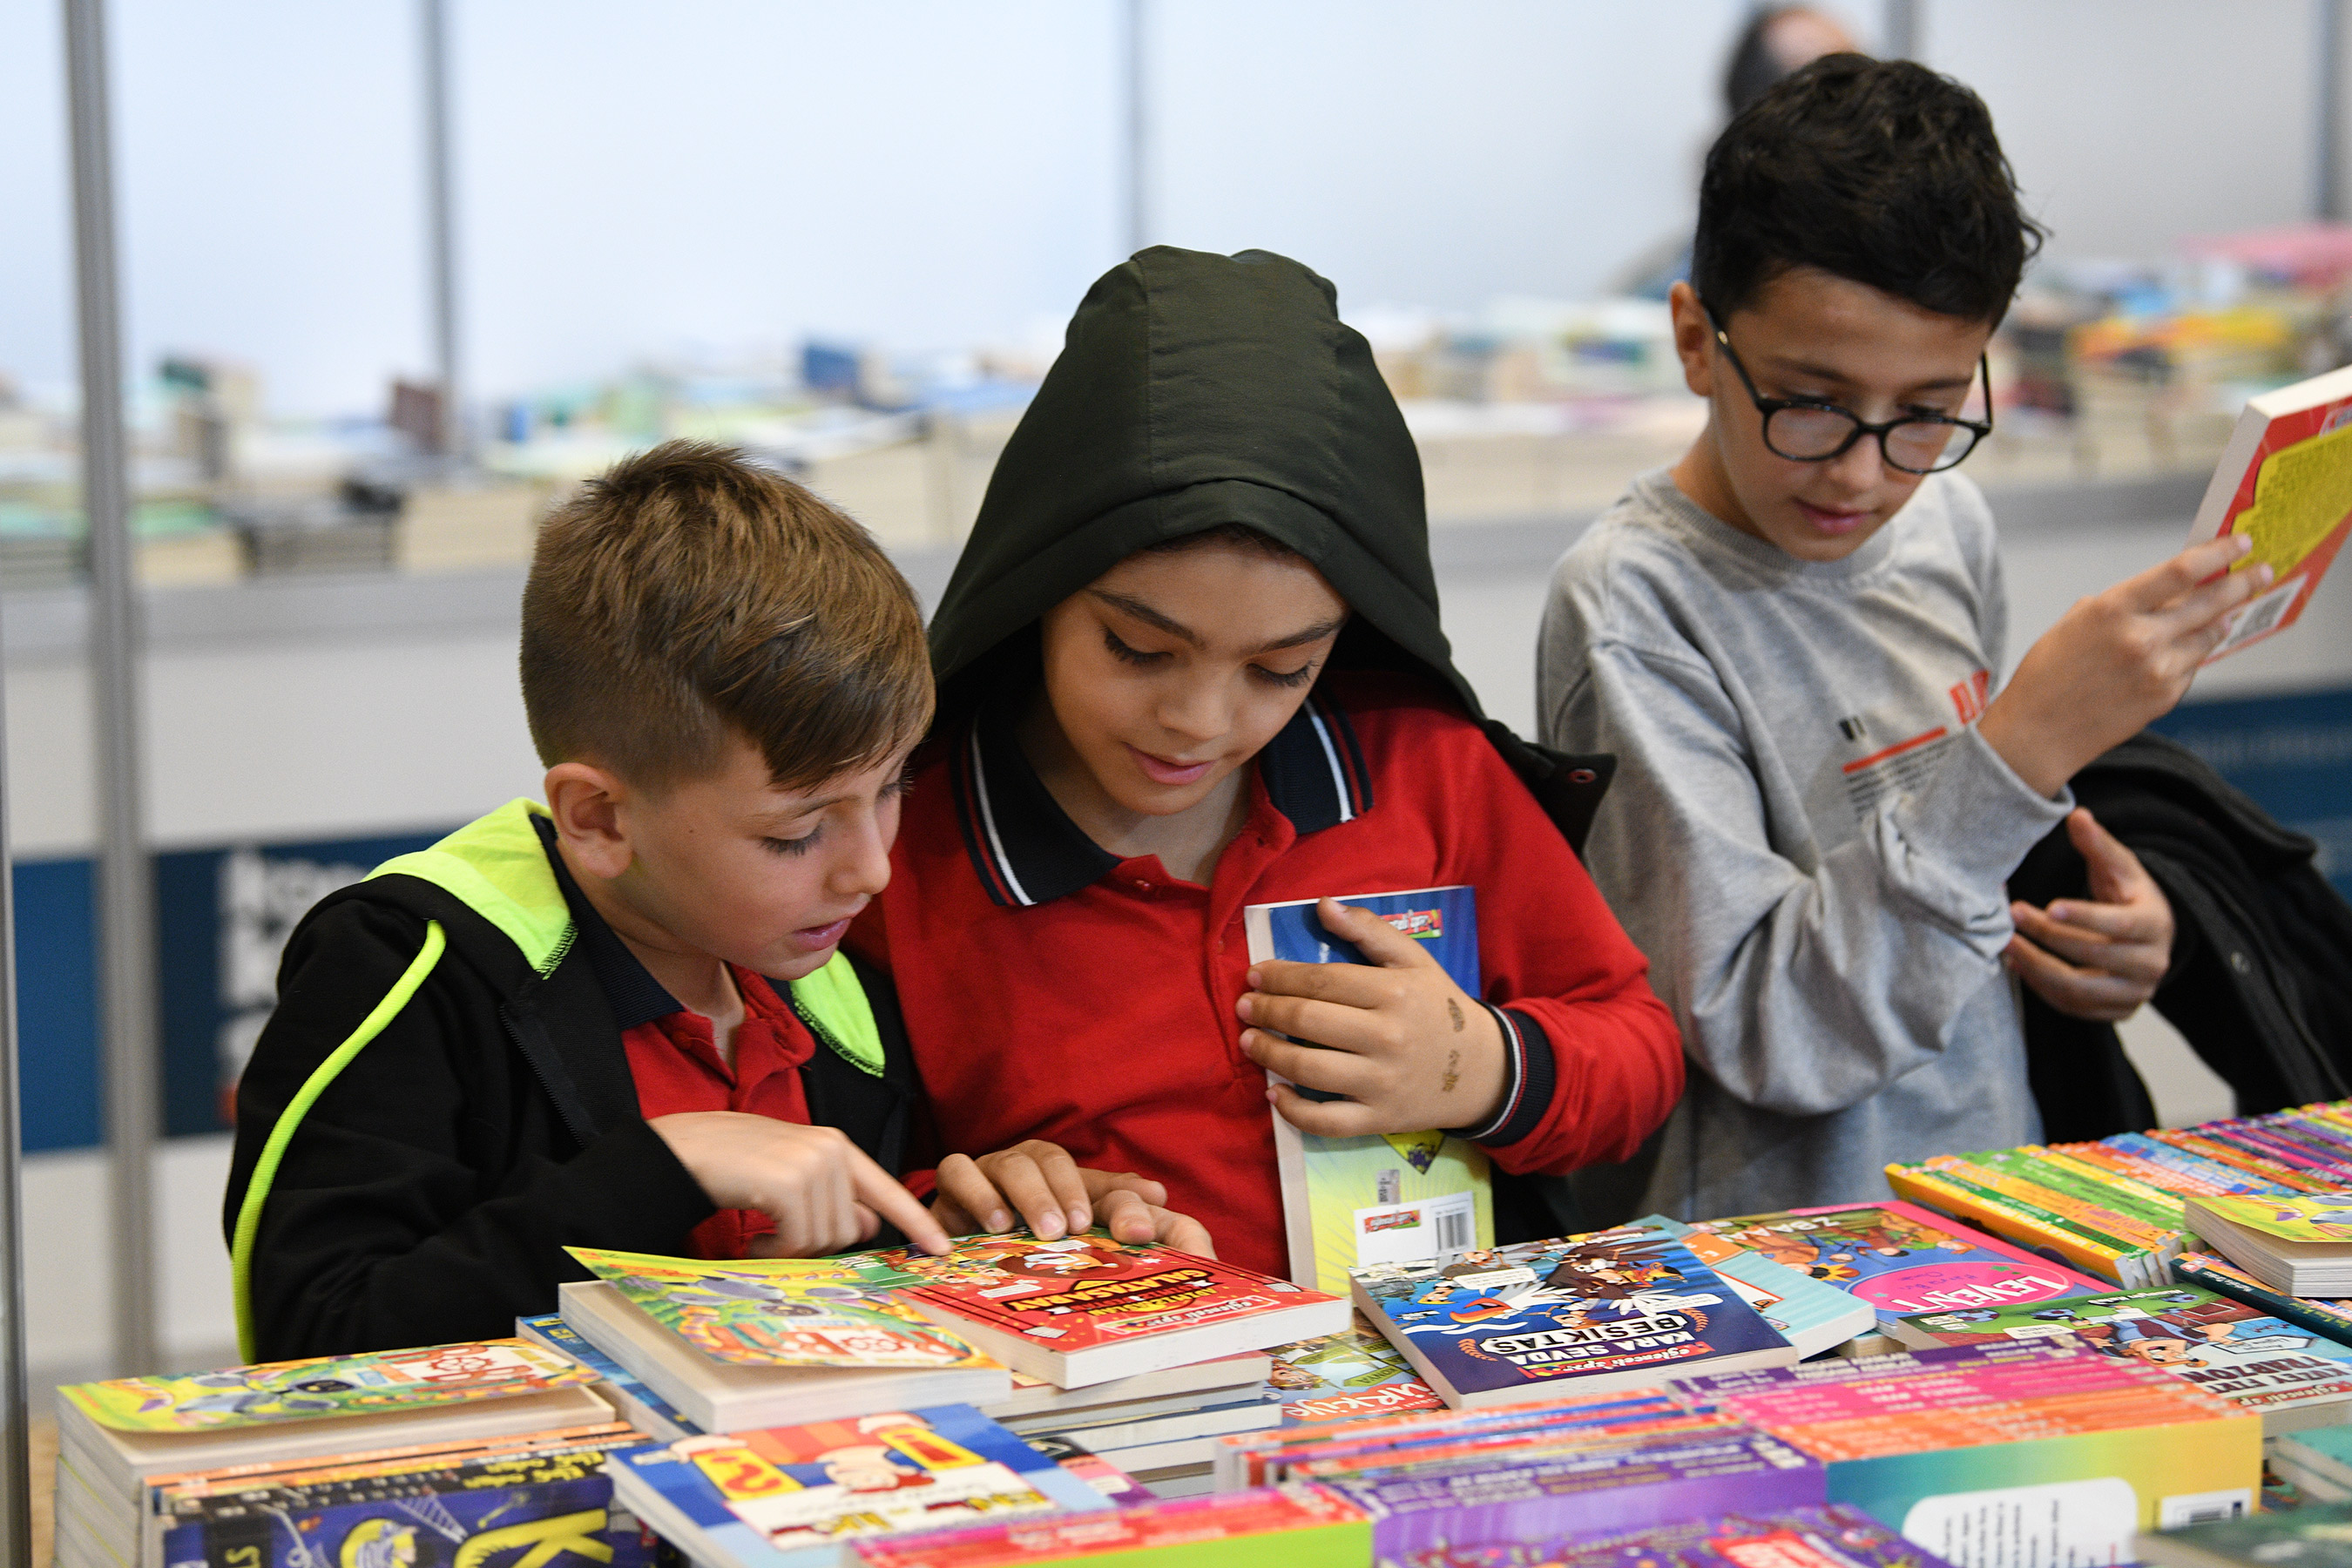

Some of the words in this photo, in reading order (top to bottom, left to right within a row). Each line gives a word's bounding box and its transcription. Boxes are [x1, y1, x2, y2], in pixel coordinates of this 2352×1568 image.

[1005, 1268, 1207, 1312] GALATASARAY
[1889, 1275, 2070, 1313] LEVENT
[1488, 1318, 1680, 1355] BEŞİKTAŞ
[1612, 1330, 1695, 1351] KARA
[1504, 1343, 1610, 1366] SEVDA
[2179, 1355, 2333, 1383] TRABZON
[2268, 1368, 2350, 1384] KUZEY
